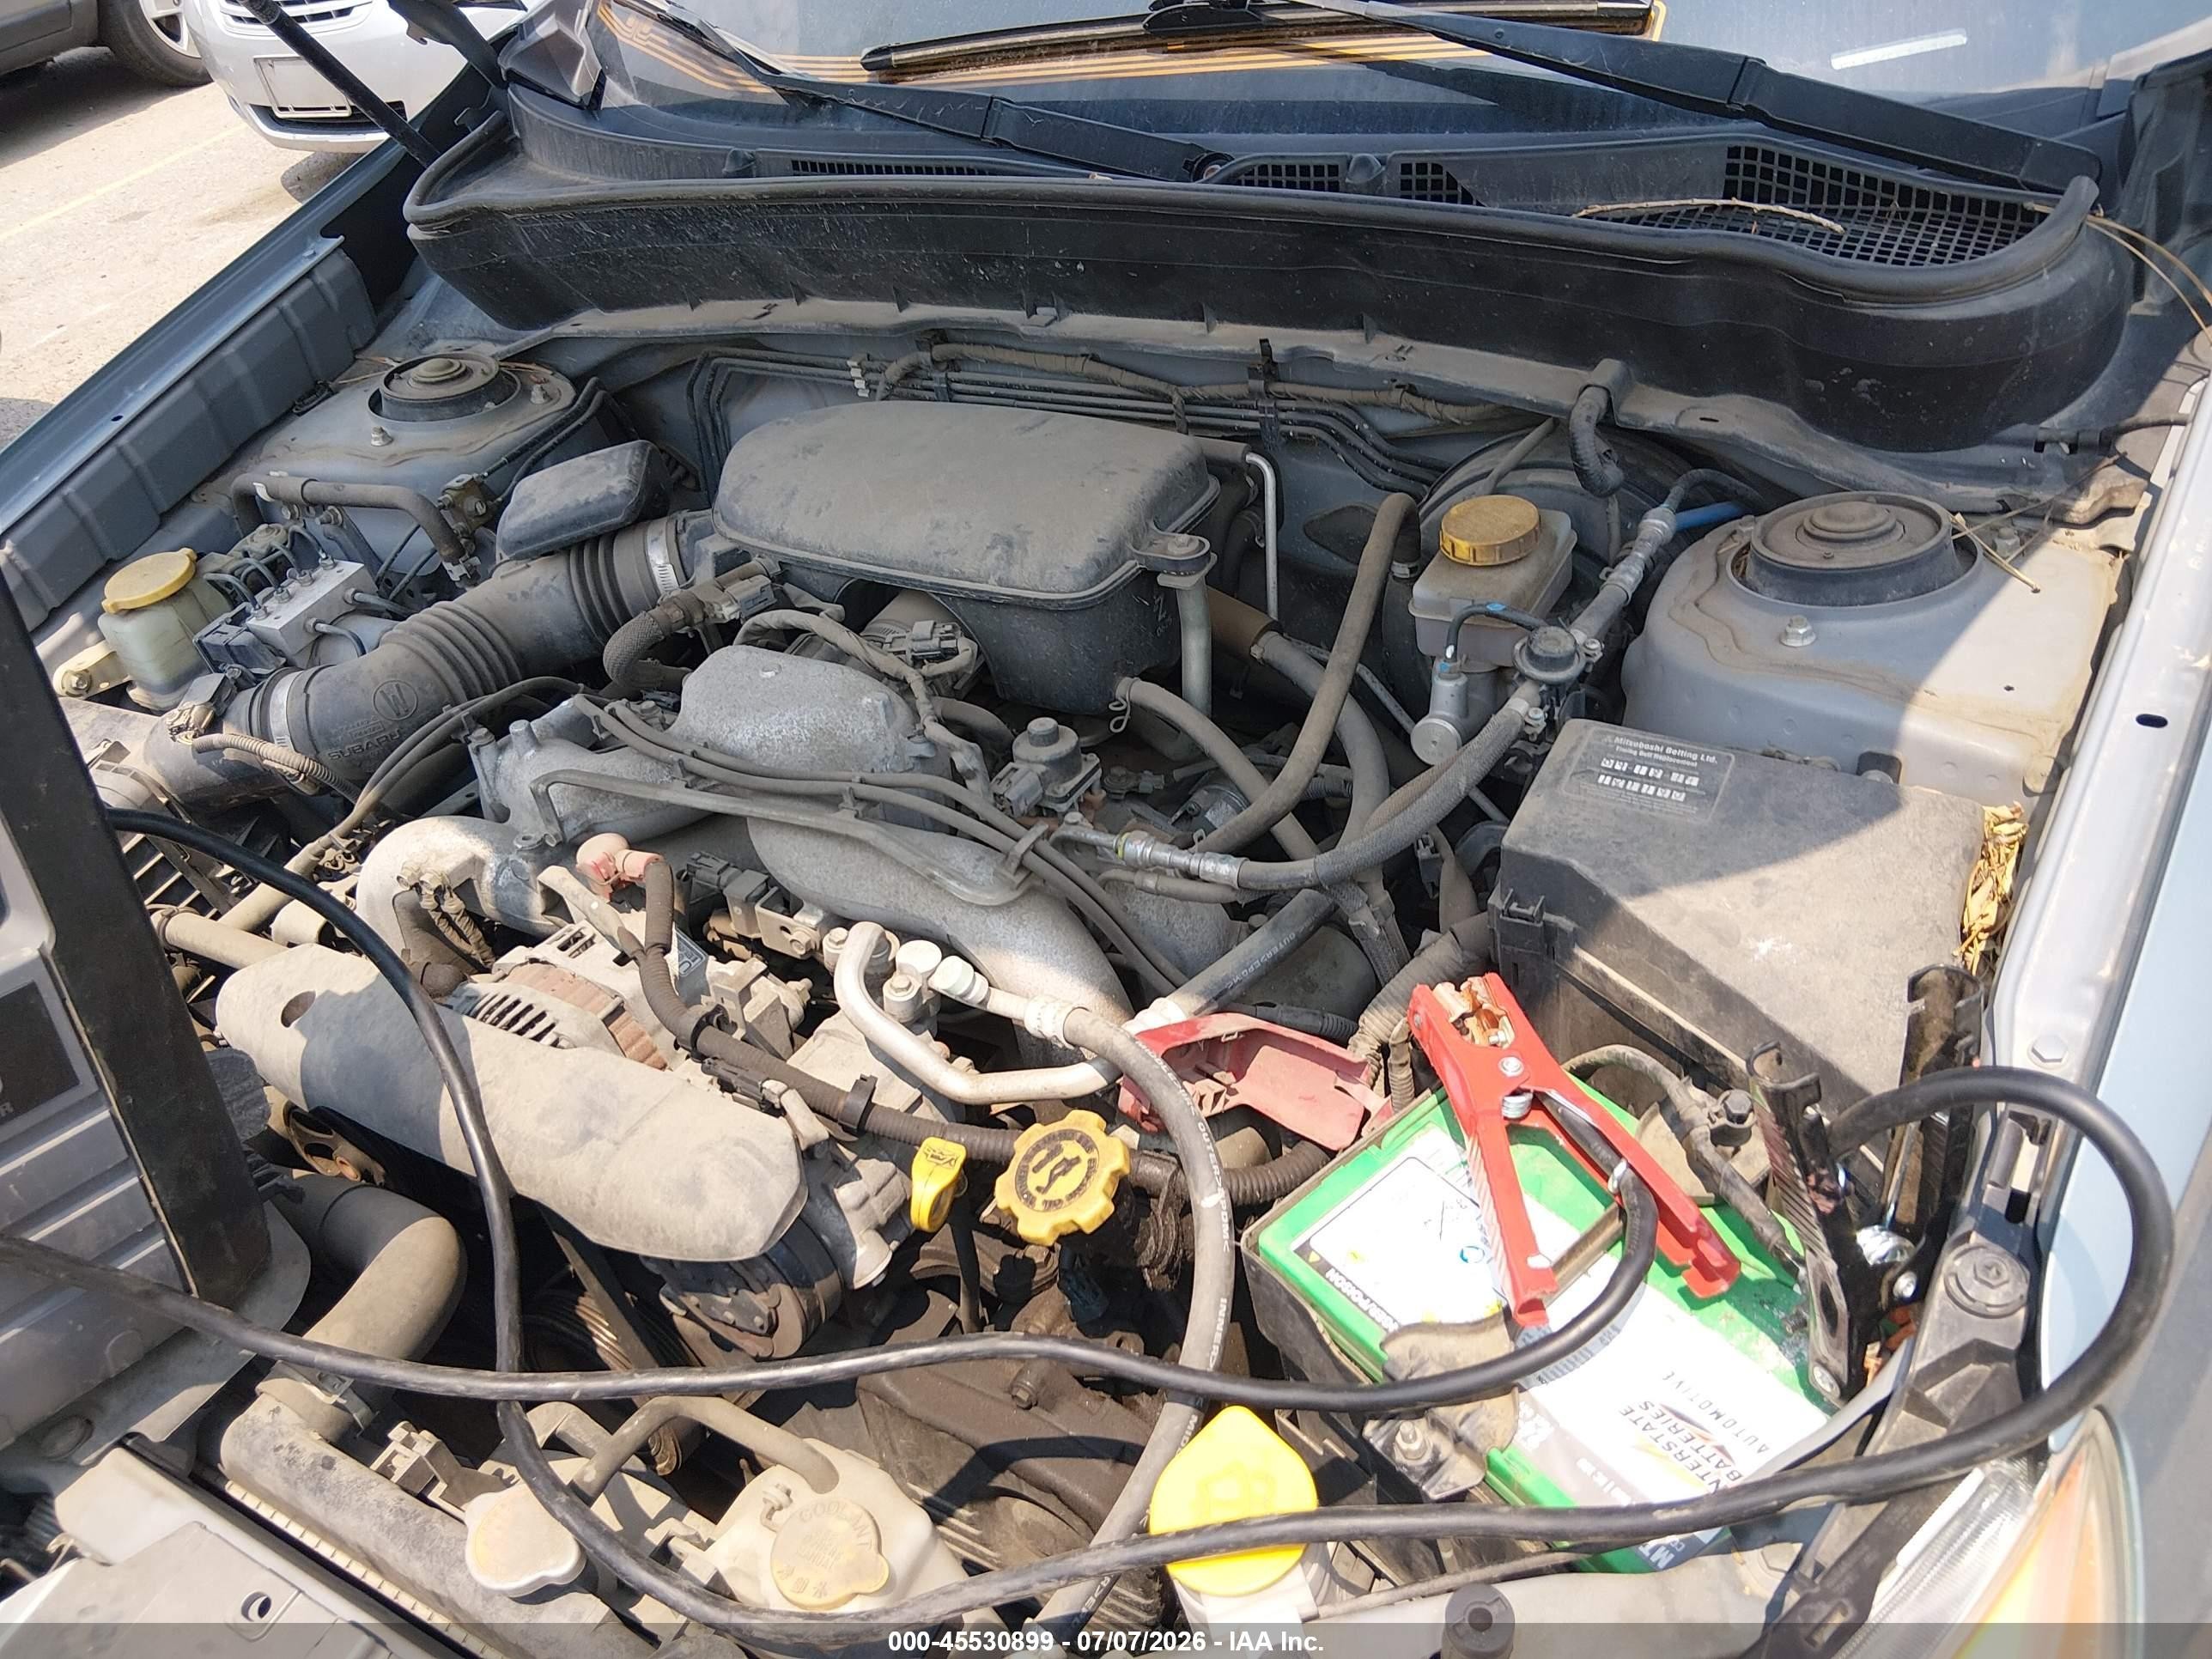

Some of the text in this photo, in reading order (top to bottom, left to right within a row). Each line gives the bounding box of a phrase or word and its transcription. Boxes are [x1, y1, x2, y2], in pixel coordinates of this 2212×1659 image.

[328, 728, 400, 760] SUBARU
[1613, 736, 1718, 764] Mitsuboshi Belting Ltd.
[1619, 1405, 1722, 1493] NTERSTATE
[1638, 1400, 1743, 1482] BATTERIES
[1662, 1370, 1770, 1454] AUTOMOTIVE
